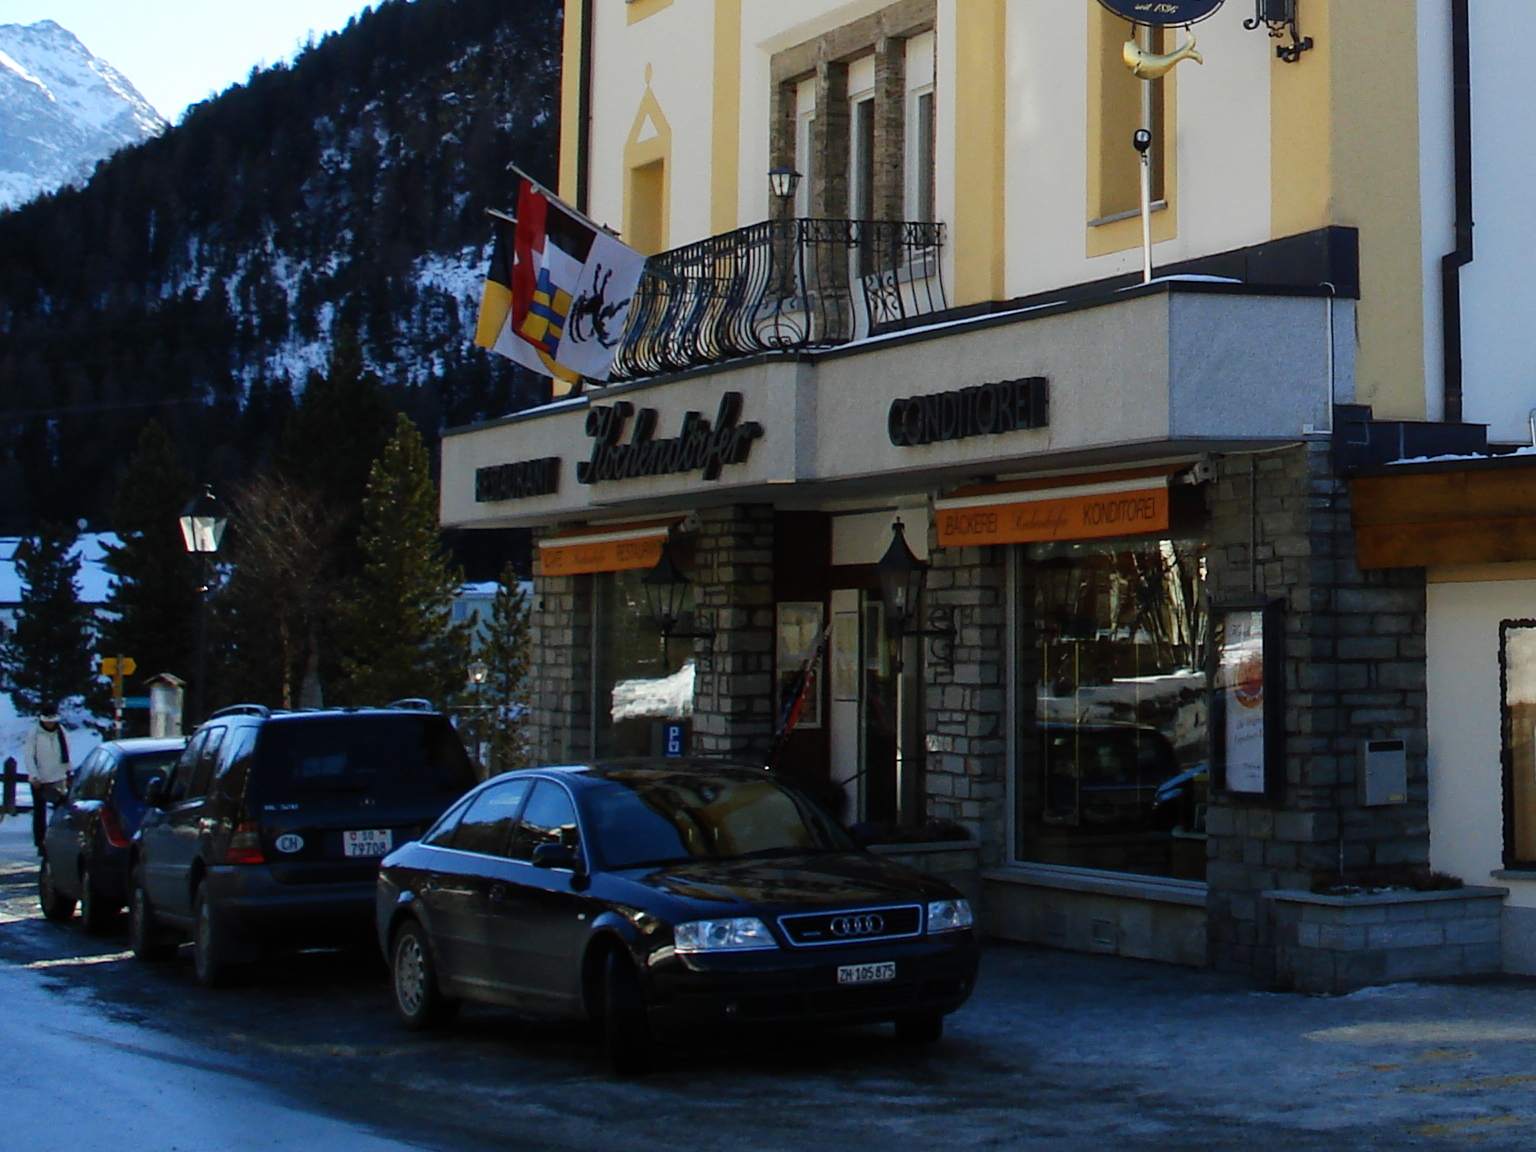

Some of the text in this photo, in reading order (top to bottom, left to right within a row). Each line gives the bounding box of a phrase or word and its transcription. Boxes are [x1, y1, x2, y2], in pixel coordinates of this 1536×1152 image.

[888, 376, 1049, 447] CONDITOREI
[1083, 497, 1156, 526] KONDITOREI
[668, 726, 680, 742] P
[281, 837, 298, 850] CH
[351, 842, 387, 856] 79708
